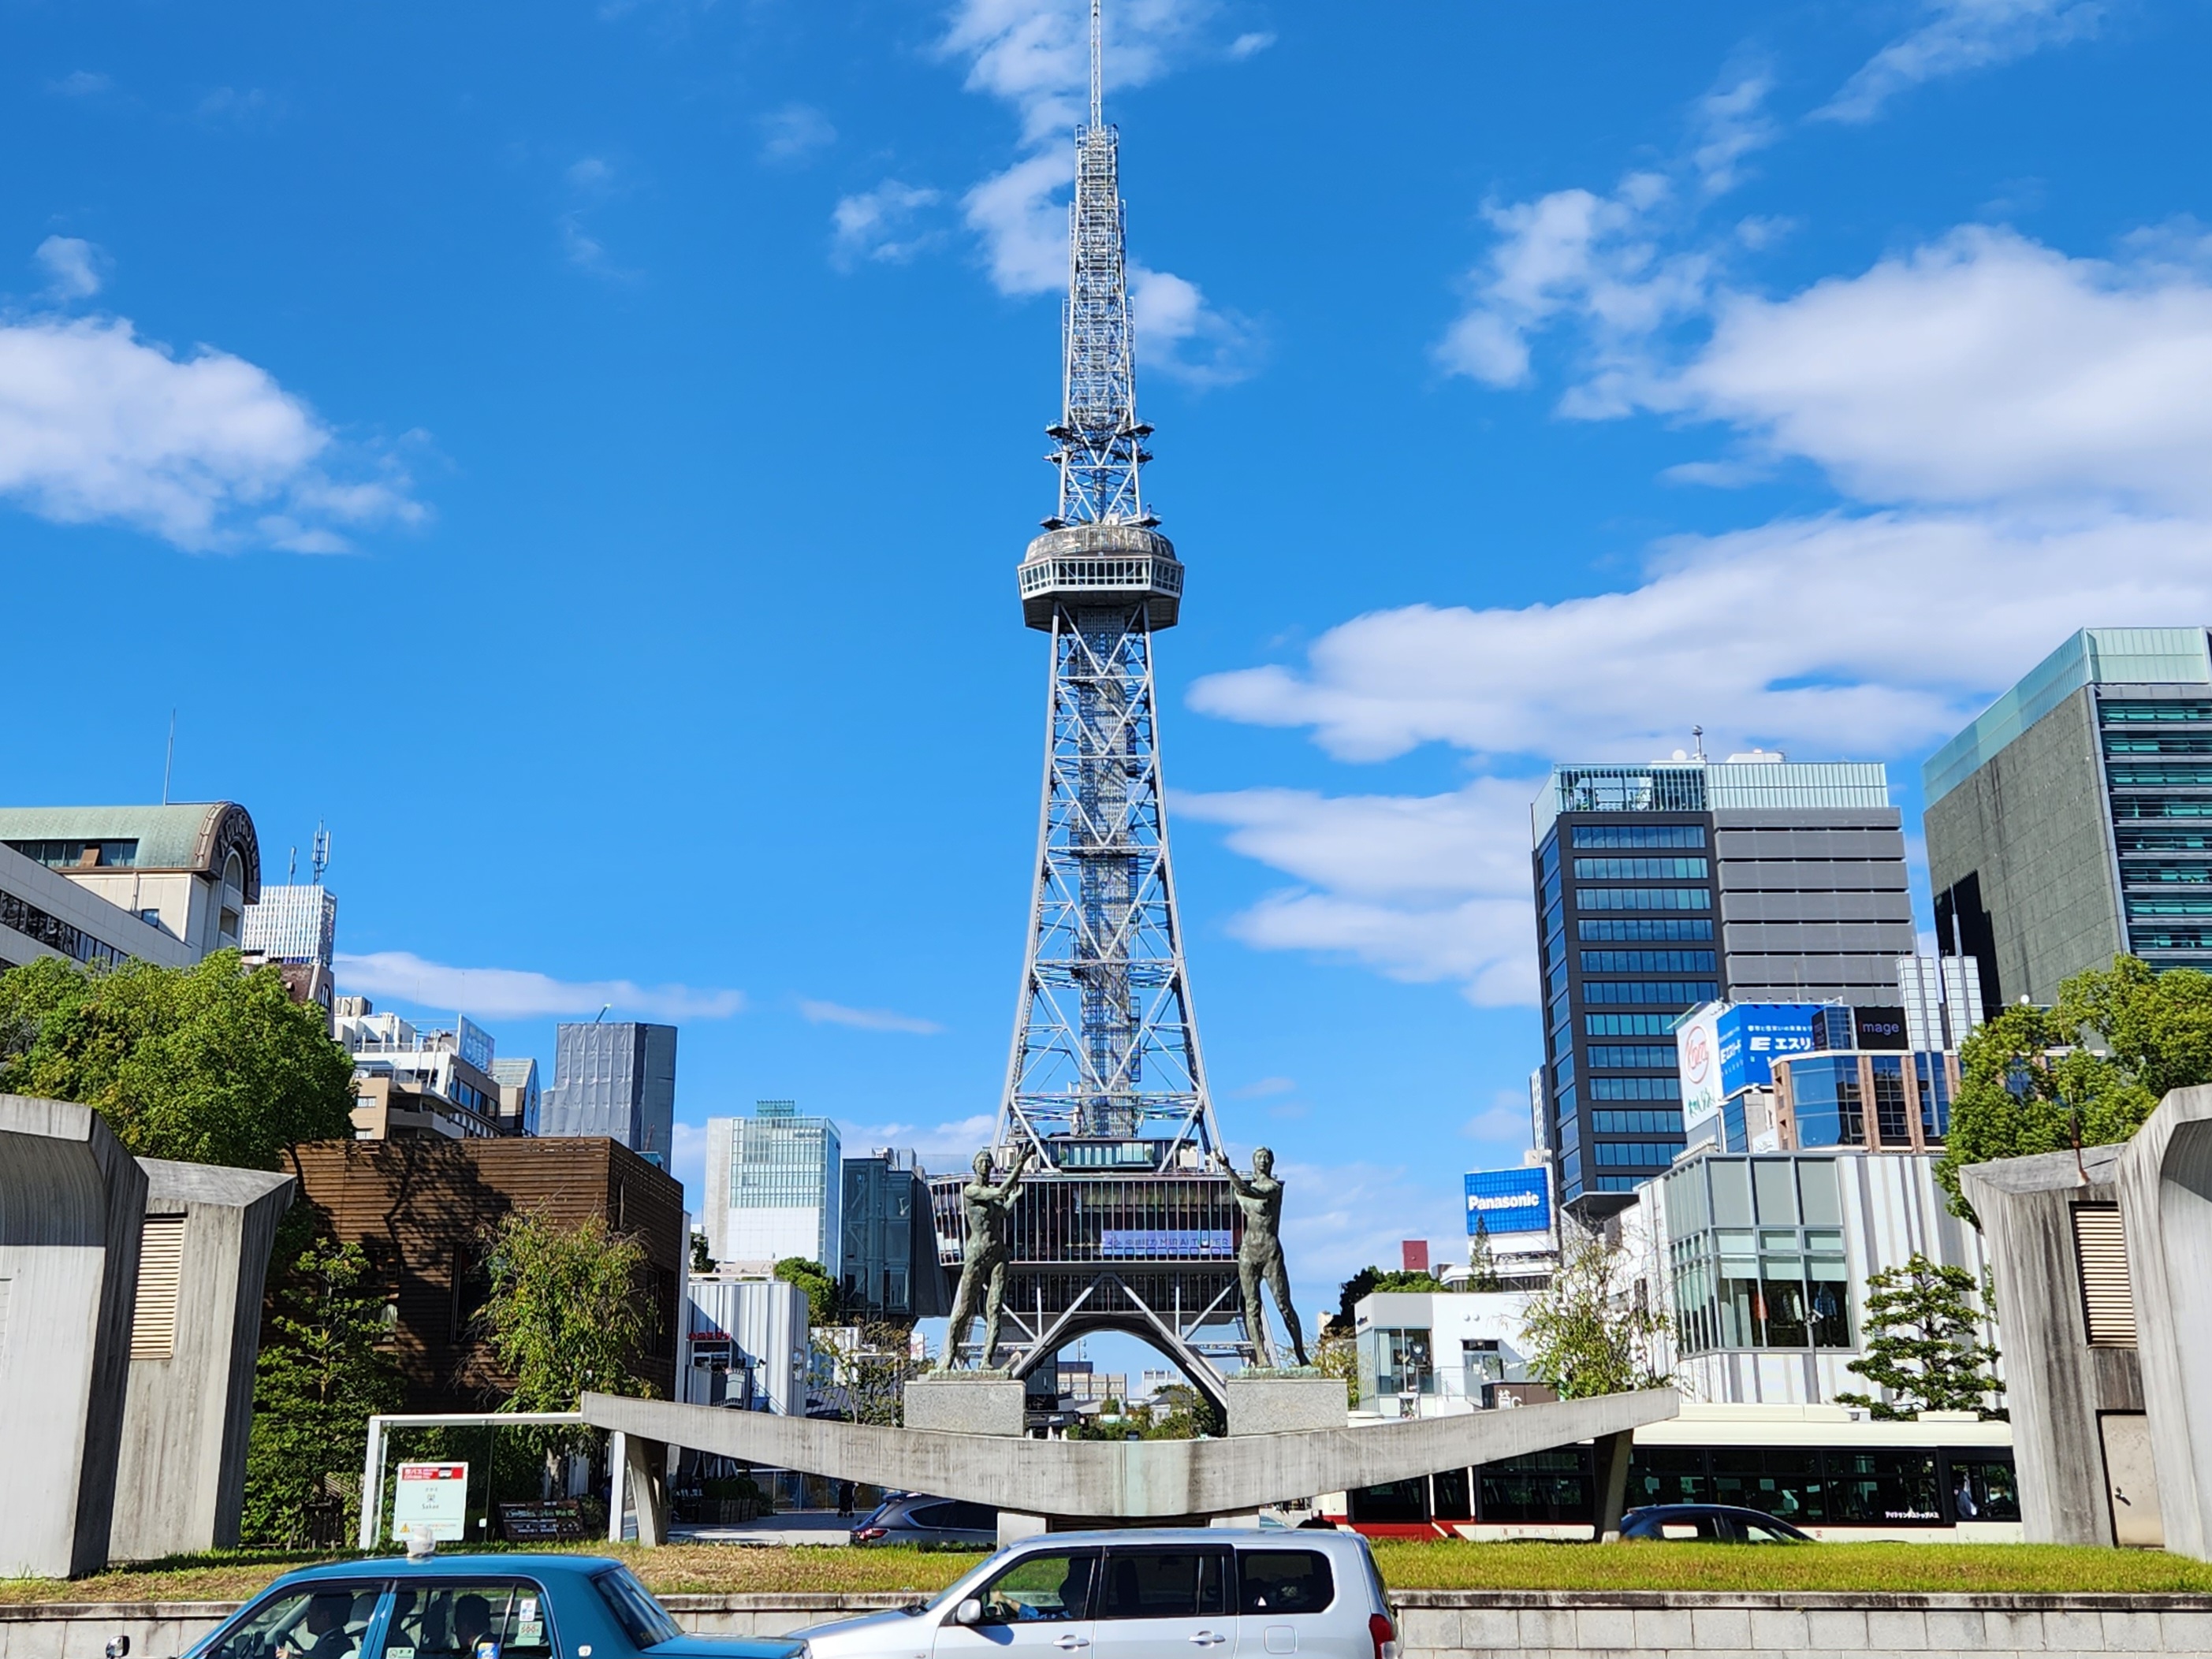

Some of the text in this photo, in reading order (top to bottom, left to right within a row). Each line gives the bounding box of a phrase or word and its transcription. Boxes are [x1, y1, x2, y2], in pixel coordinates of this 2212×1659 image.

[1774, 1037, 1815, 1051] エスリ
[1467, 1190, 1540, 1211] Panasonic
[1160, 1238, 1189, 1247] MIRAI
